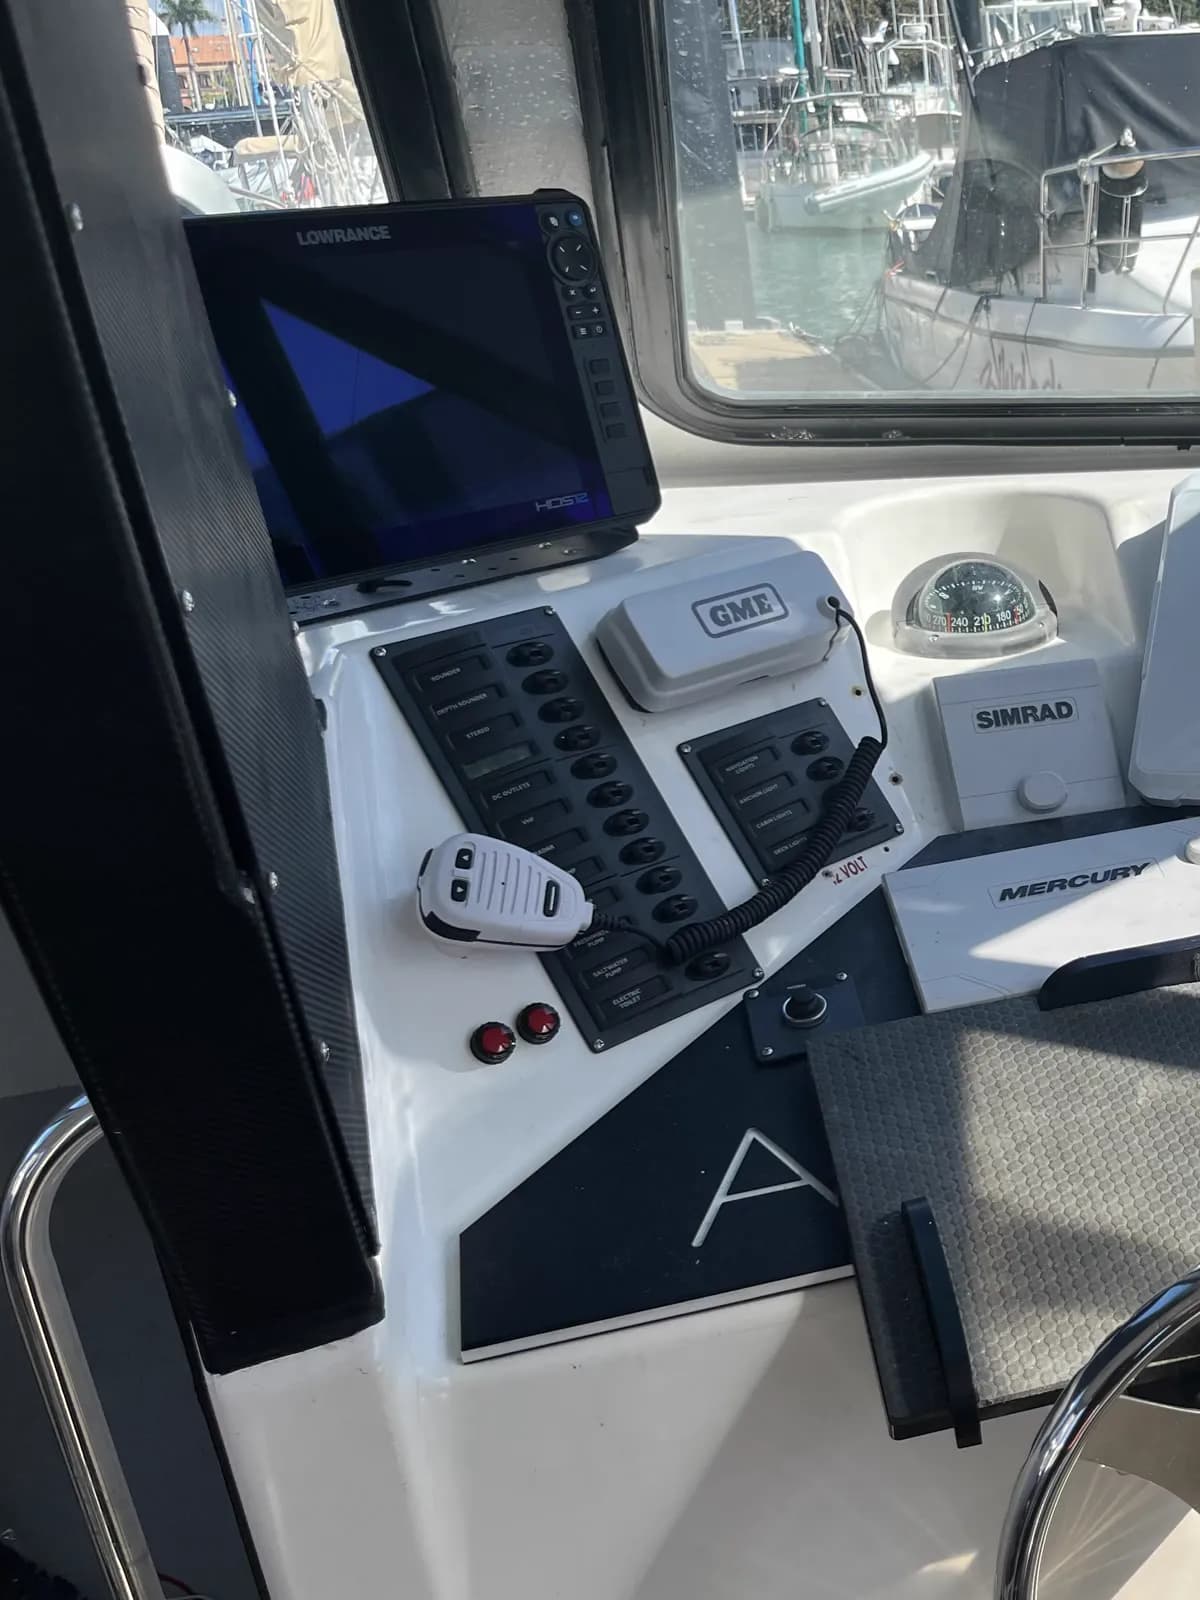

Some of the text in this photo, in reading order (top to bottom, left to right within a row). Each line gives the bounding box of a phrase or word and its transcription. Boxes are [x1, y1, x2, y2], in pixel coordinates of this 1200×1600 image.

[296, 225, 391, 246] LOWRANCE
[709, 592, 775, 627] GME
[951, 616, 969, 627] 240
[974, 614, 991, 626] 210
[996, 610, 1012, 622] 180
[976, 701, 1074, 729] SIMRAD
[491, 791, 503, 801] DC
[839, 855, 868, 878] VOLT
[999, 862, 1151, 902] MERCURY
[611, 988, 641, 1006] ELECTRIC
